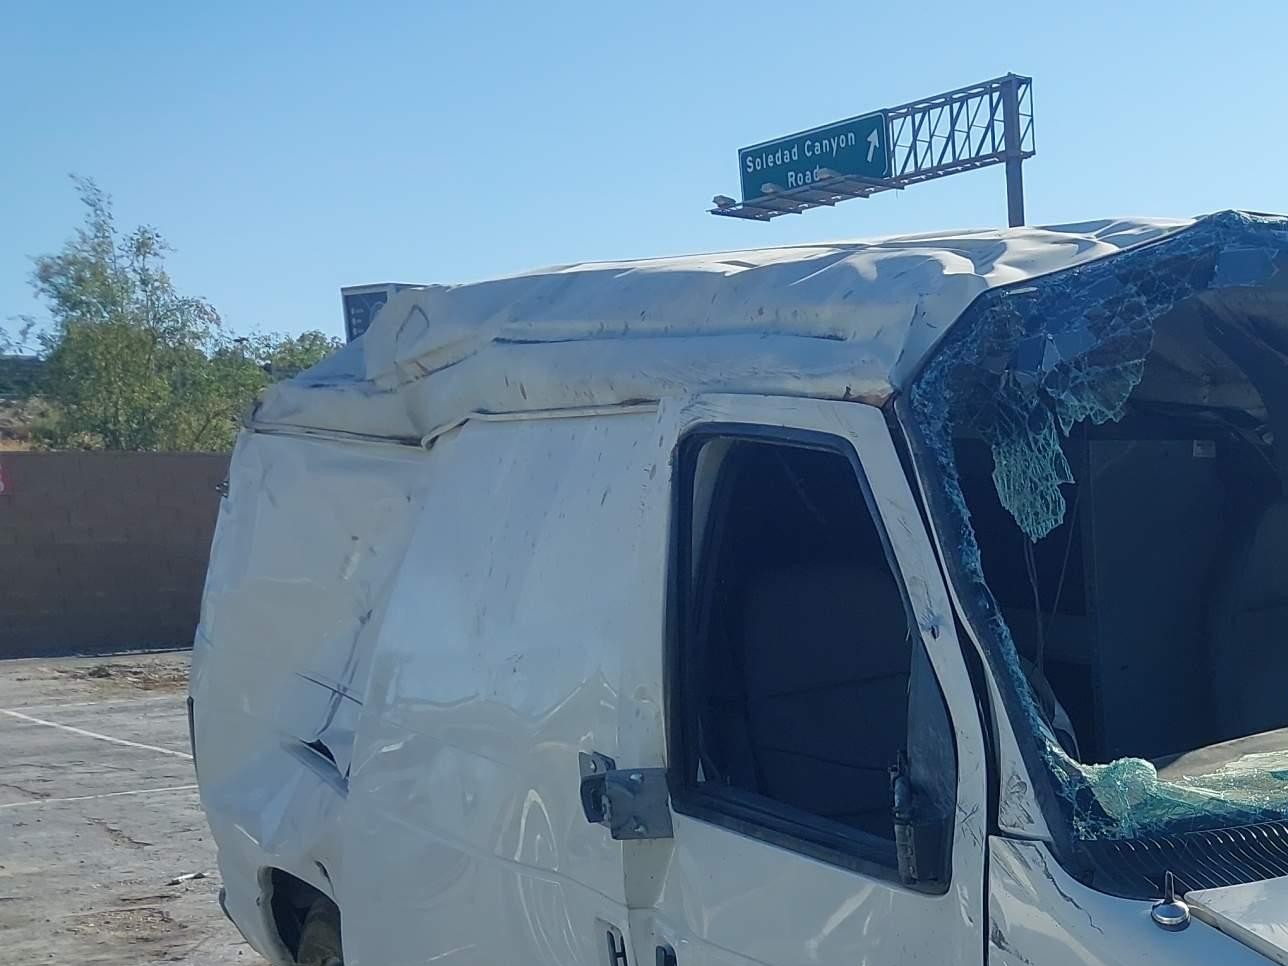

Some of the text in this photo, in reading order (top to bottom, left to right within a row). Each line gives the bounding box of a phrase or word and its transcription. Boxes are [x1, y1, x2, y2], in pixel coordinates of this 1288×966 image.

[746, 132, 856, 173] Soledad Canyon
[787, 164, 820, 188] Road
